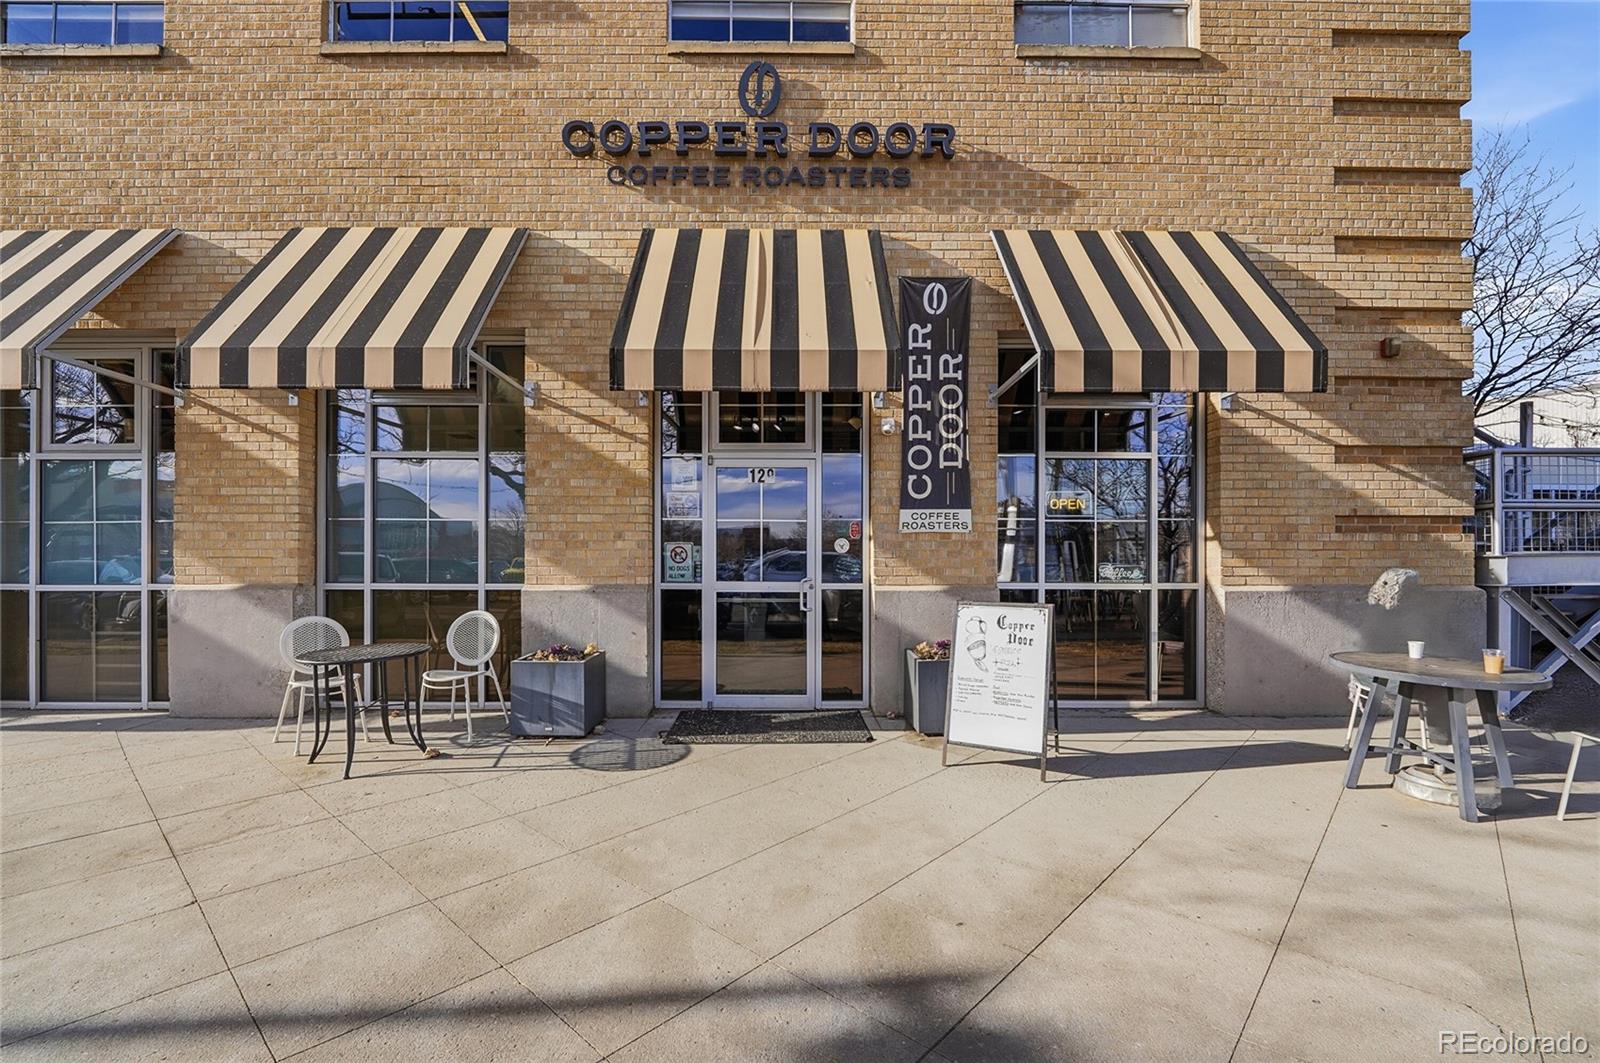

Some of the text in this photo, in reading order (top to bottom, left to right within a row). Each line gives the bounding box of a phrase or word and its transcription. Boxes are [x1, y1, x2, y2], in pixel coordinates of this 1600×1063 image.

[562, 120, 956, 159] COPPER DOOR
[607, 165, 912, 188] COFFEE ROASTERS
[907, 323, 932, 500] COPPER
[938, 353, 963, 469] DOOR
[1050, 498, 1086, 510] OPEN
[901, 521, 969, 530] ROASTERS
[911, 512, 960, 521] COFFEE
[997, 614, 1036, 633] Copper
[1007, 631, 1034, 647] Door
